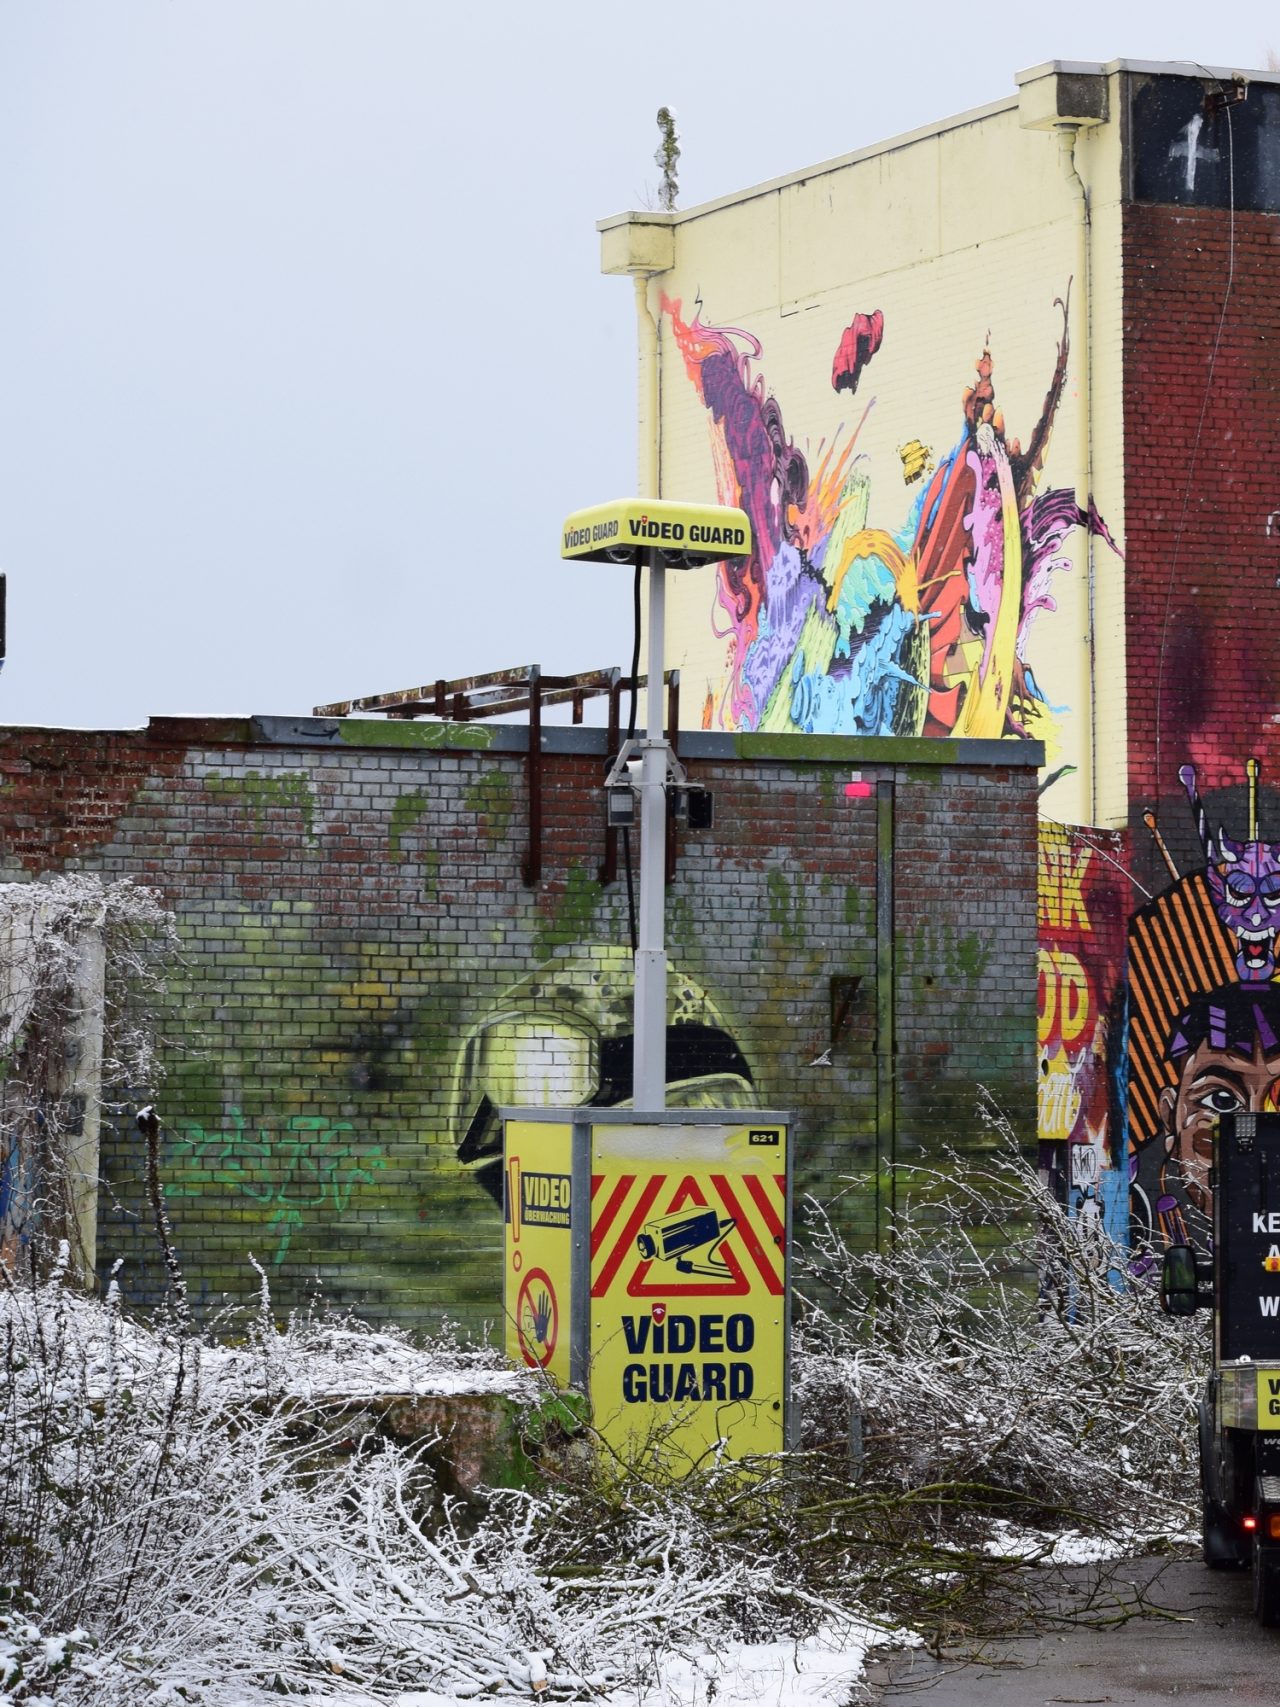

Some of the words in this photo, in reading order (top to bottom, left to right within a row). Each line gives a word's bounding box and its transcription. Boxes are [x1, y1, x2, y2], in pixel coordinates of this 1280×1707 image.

[592, 520, 619, 541] GUARD
[689, 525, 745, 546] GUARD
[752, 1134, 774, 1143] 621
[524, 1176, 571, 1209] VIDEO
[623, 1362, 754, 1403] GUARD
